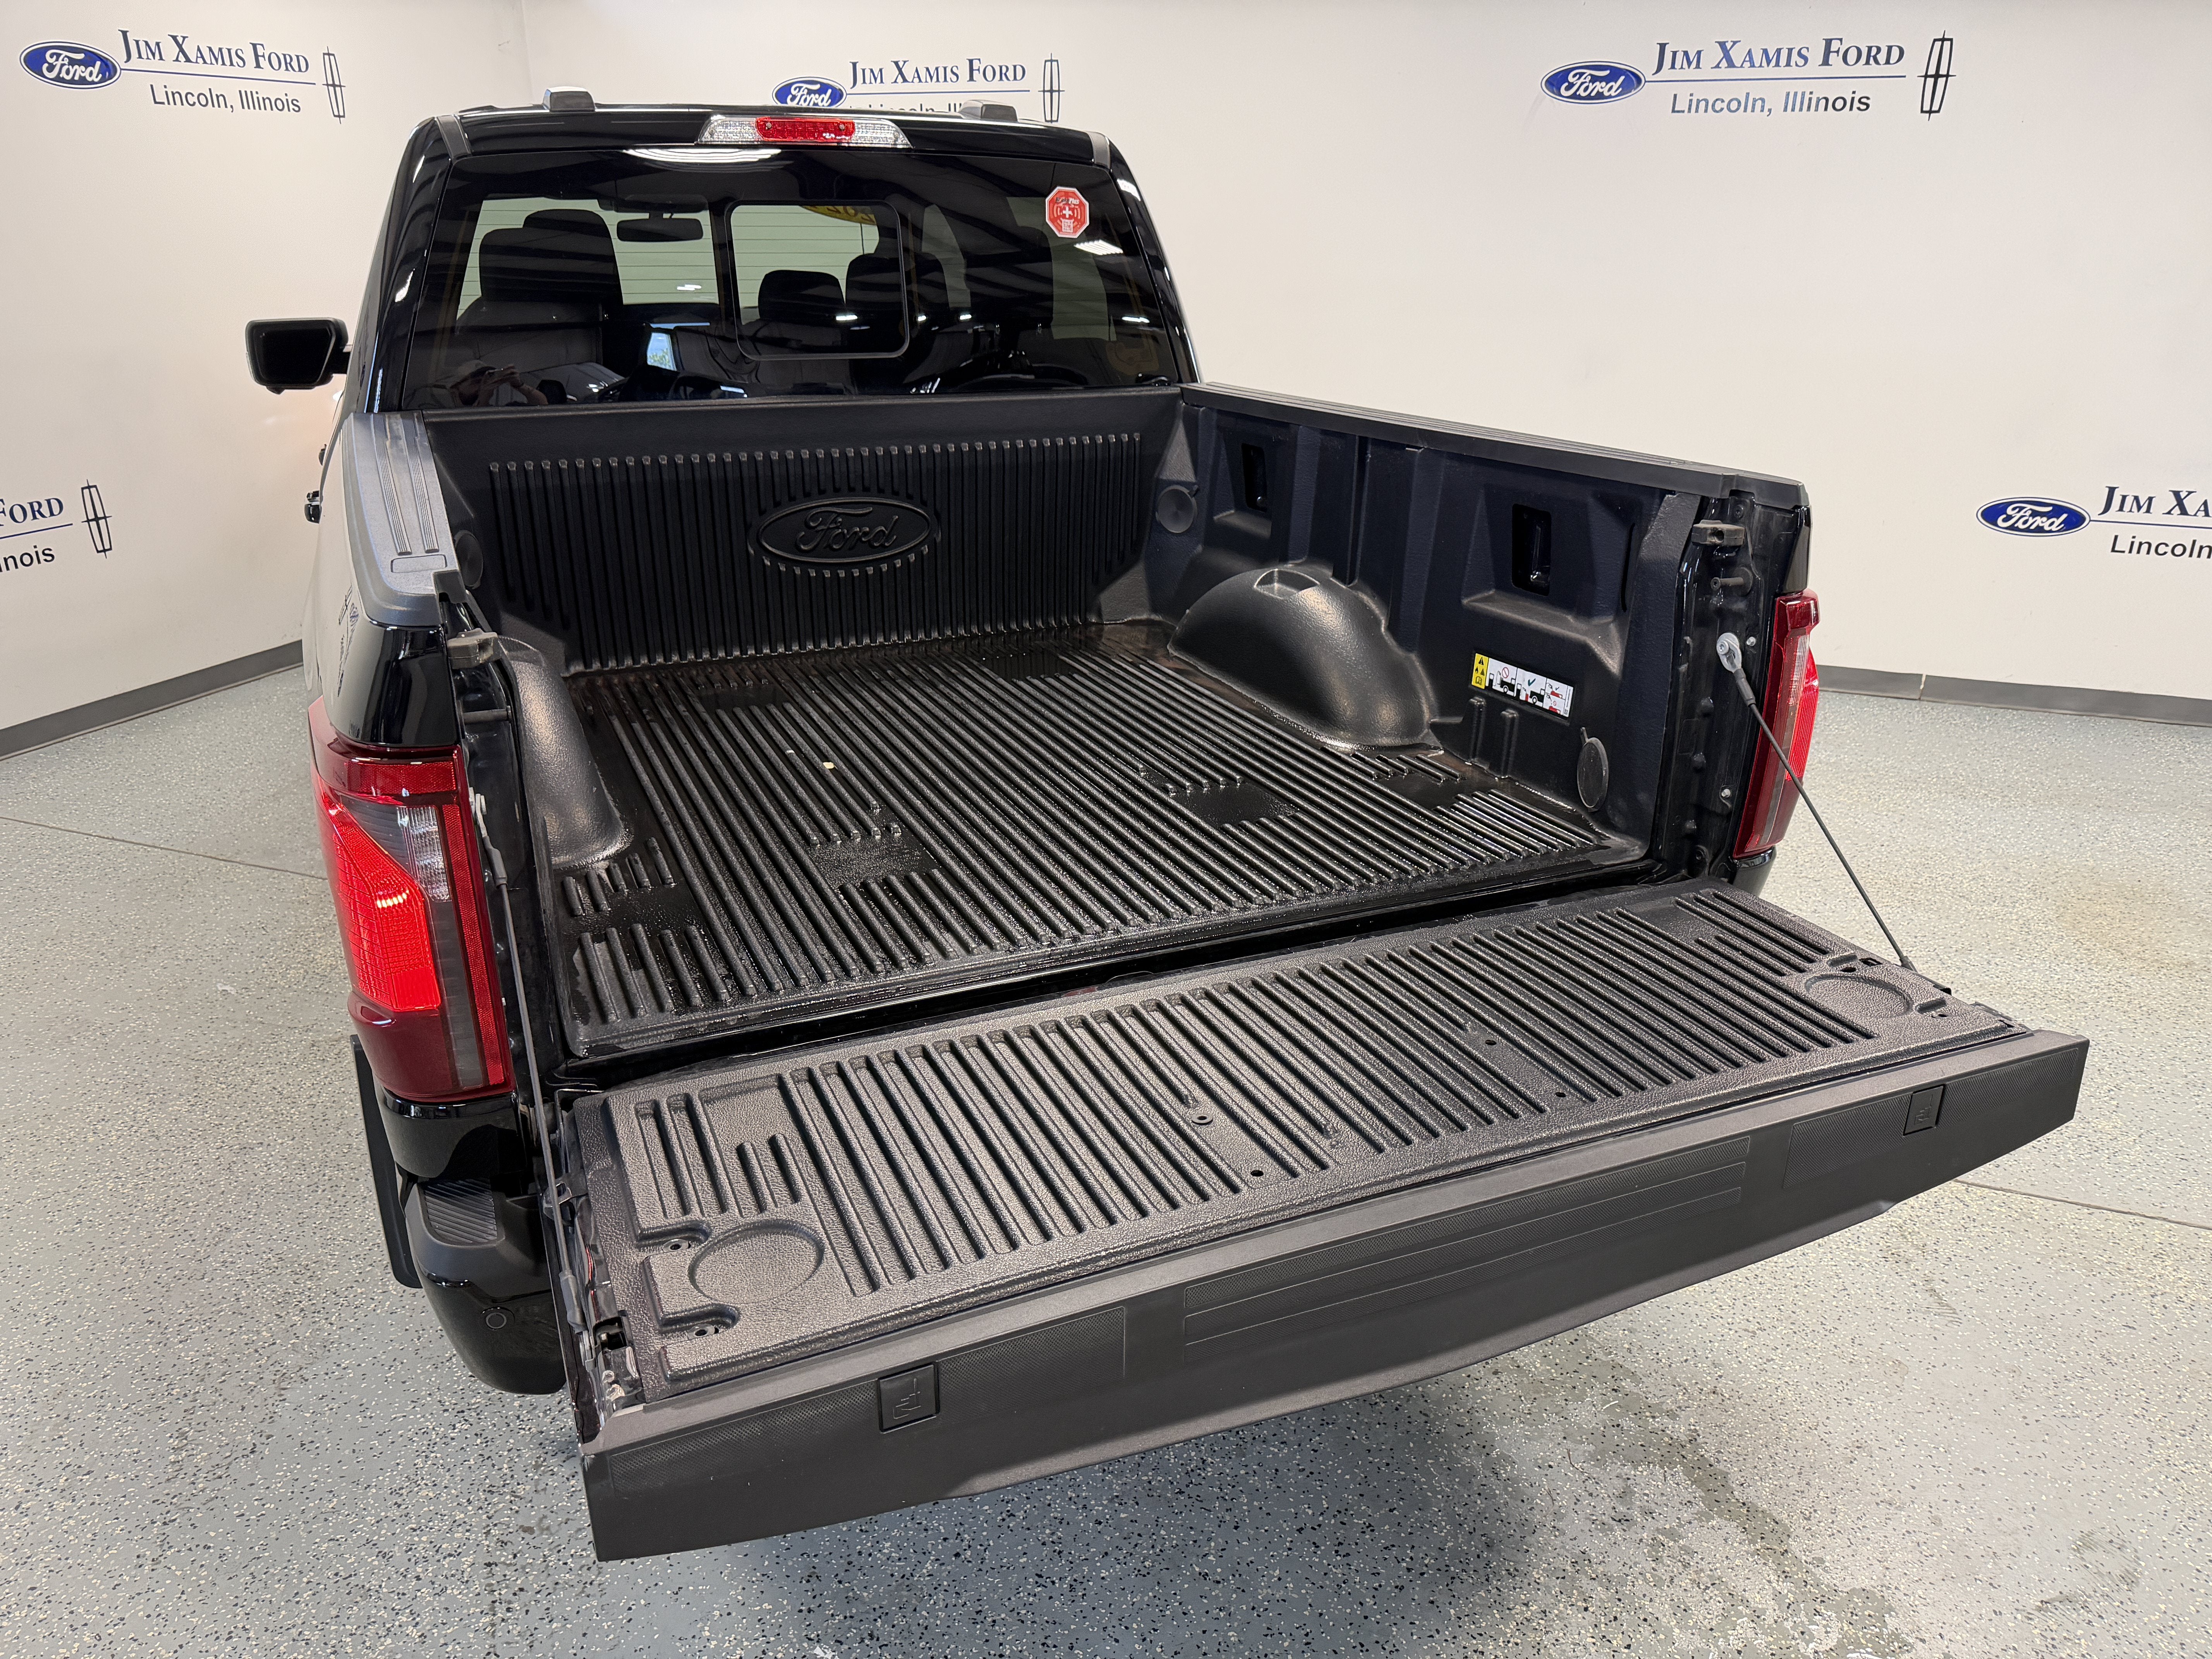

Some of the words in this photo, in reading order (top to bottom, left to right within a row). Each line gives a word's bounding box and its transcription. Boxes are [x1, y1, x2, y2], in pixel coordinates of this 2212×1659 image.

[42, 49, 102, 82] Ford
[117, 29, 165, 63] JIM
[167, 34, 246, 68] XAMIS
[249, 42, 309, 73] FORD
[1651, 42, 1704, 76] JIM
[1711, 40, 1809, 69] XAMIS
[1818, 37, 1905, 67] FORD
[849, 61, 884, 89] JIM
[891, 60, 959, 84] XAMIS
[966, 58, 1026, 82] FORD
[1560, 69, 1625, 97] Ford
[150, 84, 234, 113] Lincoln,
[238, 89, 301, 113] Illinois
[787, 83, 832, 107] Ford
[1671, 92, 1772, 117] Lincoln,
[1783, 90, 1870, 112] Illinois
[2097, 486, 2156, 516] JIM
[795, 506, 899, 551] Ford
[1997, 503, 2068, 532] Ford
